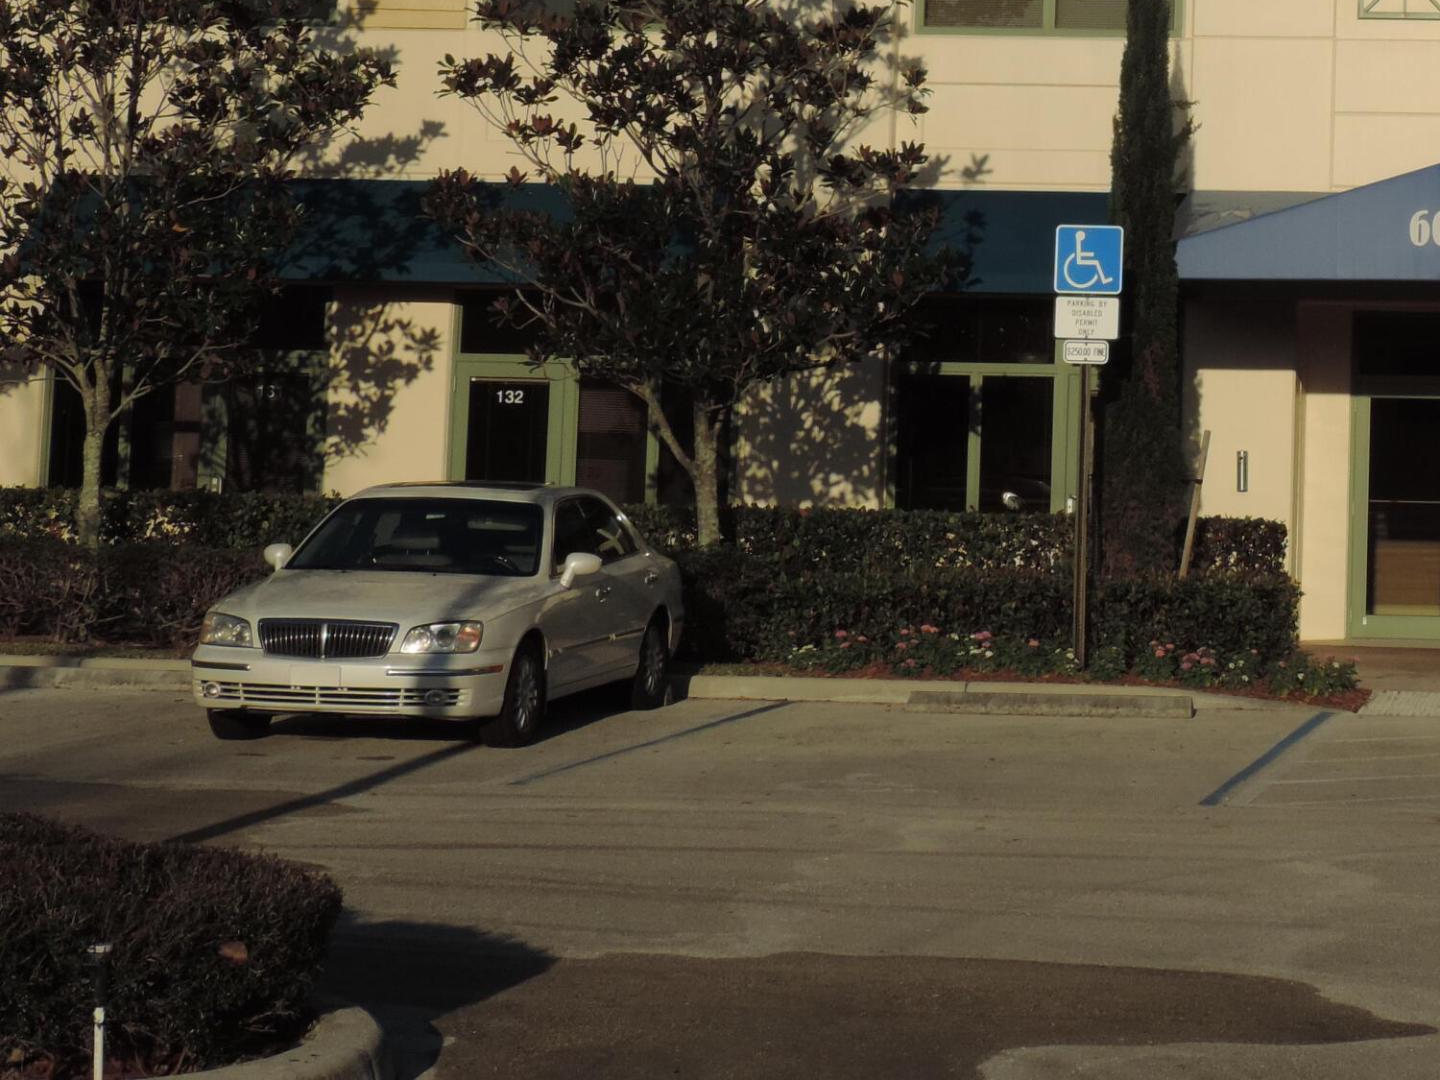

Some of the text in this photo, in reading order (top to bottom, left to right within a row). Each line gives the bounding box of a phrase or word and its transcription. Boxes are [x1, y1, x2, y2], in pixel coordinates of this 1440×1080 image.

[1067, 300, 1108, 308] PARKING BY
[1071, 309, 1103, 317] DISABLED
[1075, 319, 1098, 327] PERMIT
[1078, 328, 1095, 336] ONLY
[496, 390, 524, 404] 132
